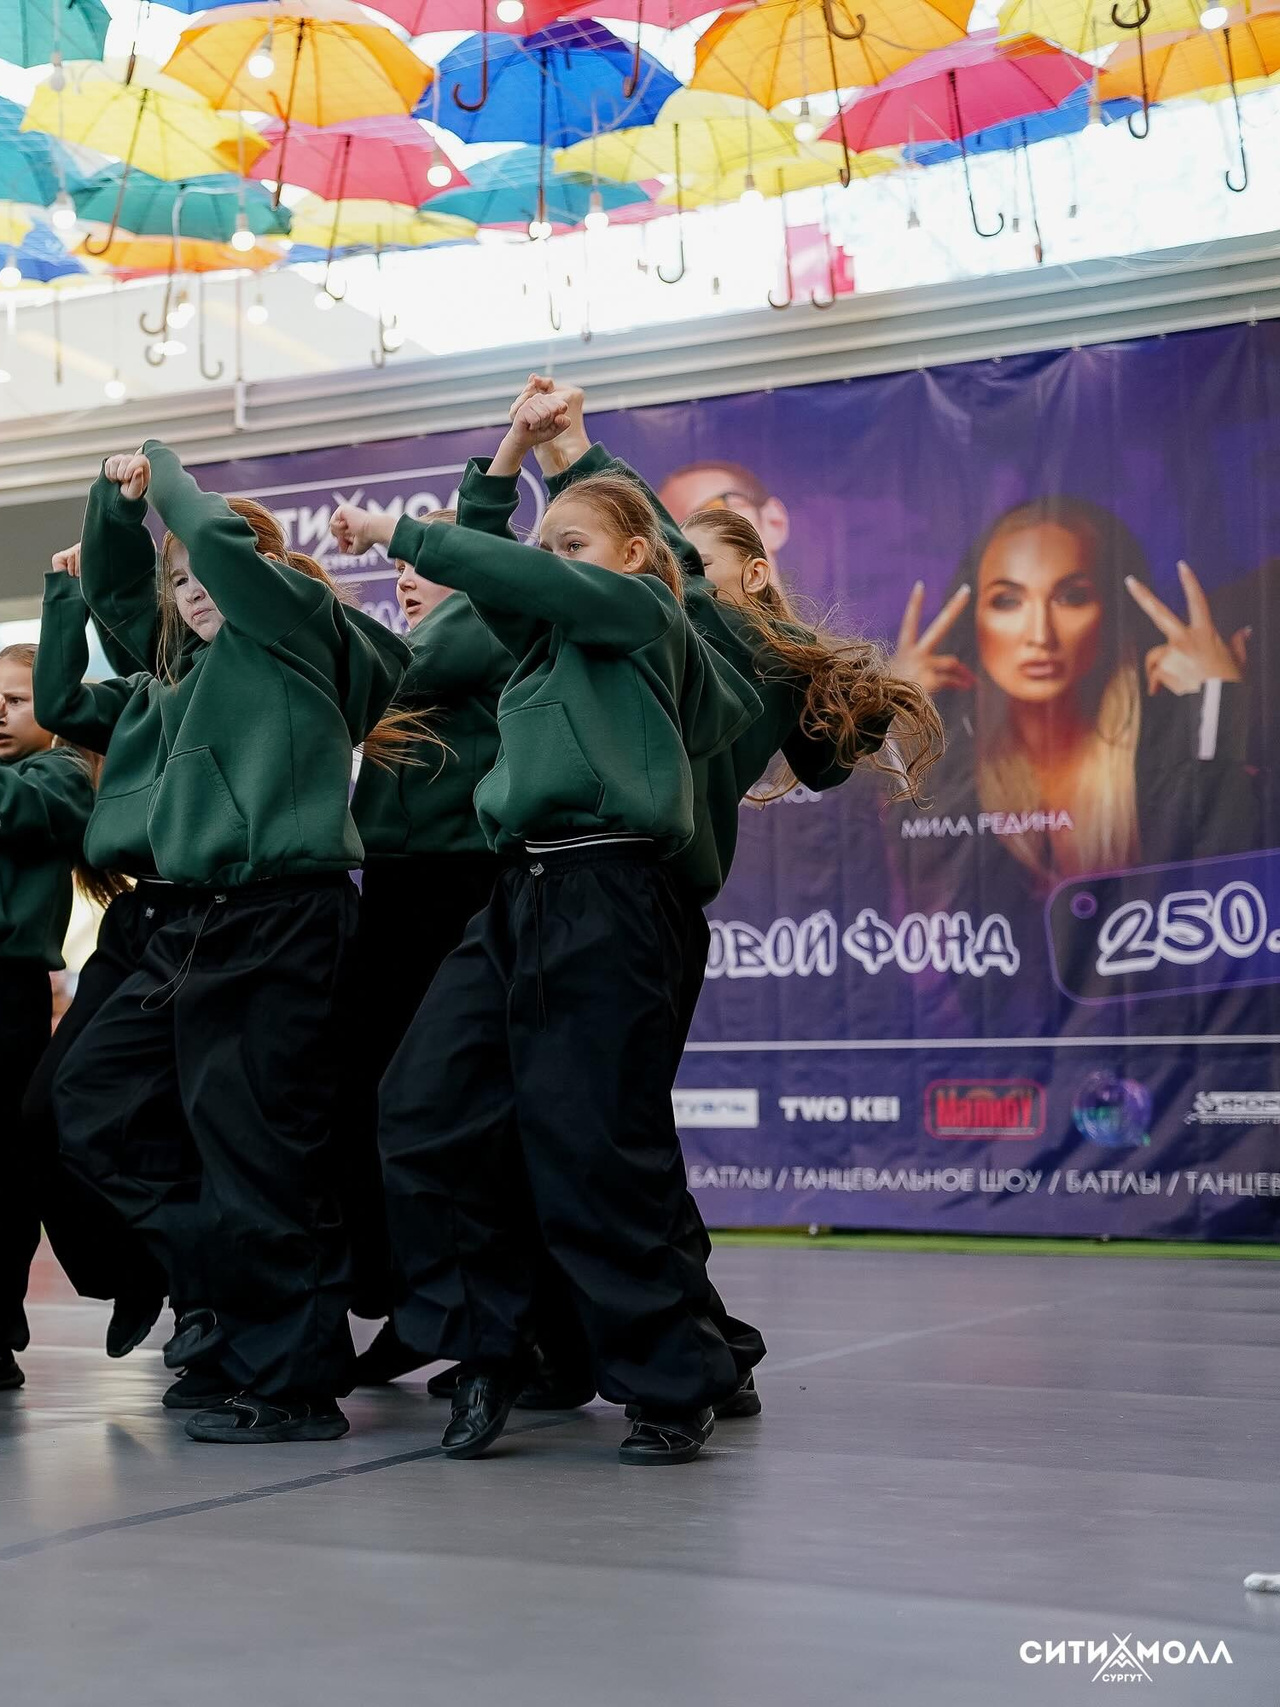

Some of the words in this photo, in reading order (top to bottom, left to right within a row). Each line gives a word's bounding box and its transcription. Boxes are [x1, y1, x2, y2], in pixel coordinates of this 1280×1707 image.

[901, 814, 972, 839] МИЛА
[977, 810, 1074, 836] РЕДИНА
[705, 909, 837, 979] ОВОЙ
[778, 1096, 848, 1122] TWO
[850, 1096, 901, 1122] KEI
[792, 1166, 974, 1192] ТАНЦЕВАЛЬНОЕ
[979, 1167, 1041, 1193] ШОУ
[1065, 1169, 1161, 1195] БАТТЛЫ
